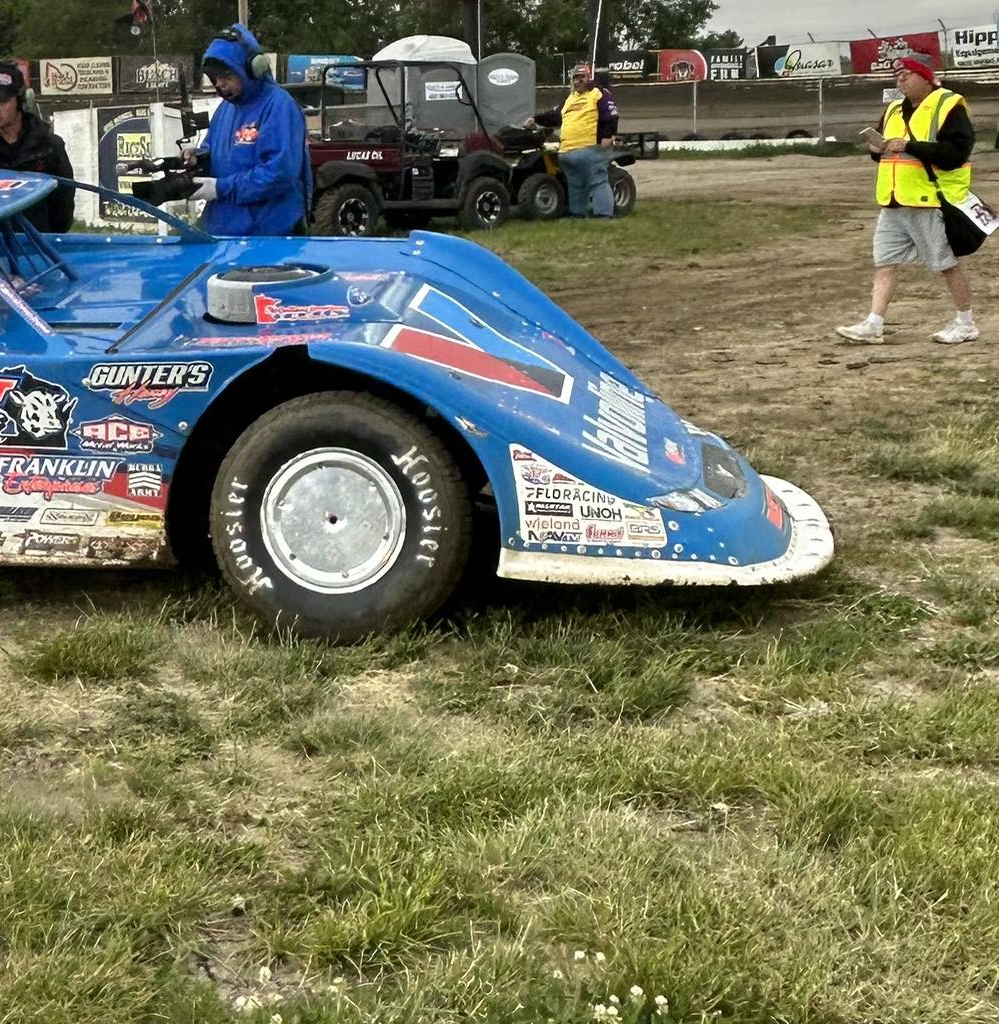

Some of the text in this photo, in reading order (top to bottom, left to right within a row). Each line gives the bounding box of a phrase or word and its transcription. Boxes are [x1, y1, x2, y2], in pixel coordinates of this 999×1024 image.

[785, 49, 834, 73] Quasar
[346, 151, 370, 161] LUCAS
[91, 363, 209, 386] GUNTER'S
[390, 445, 448, 568] Hoosier
[580, 506, 623, 521] UNOH
